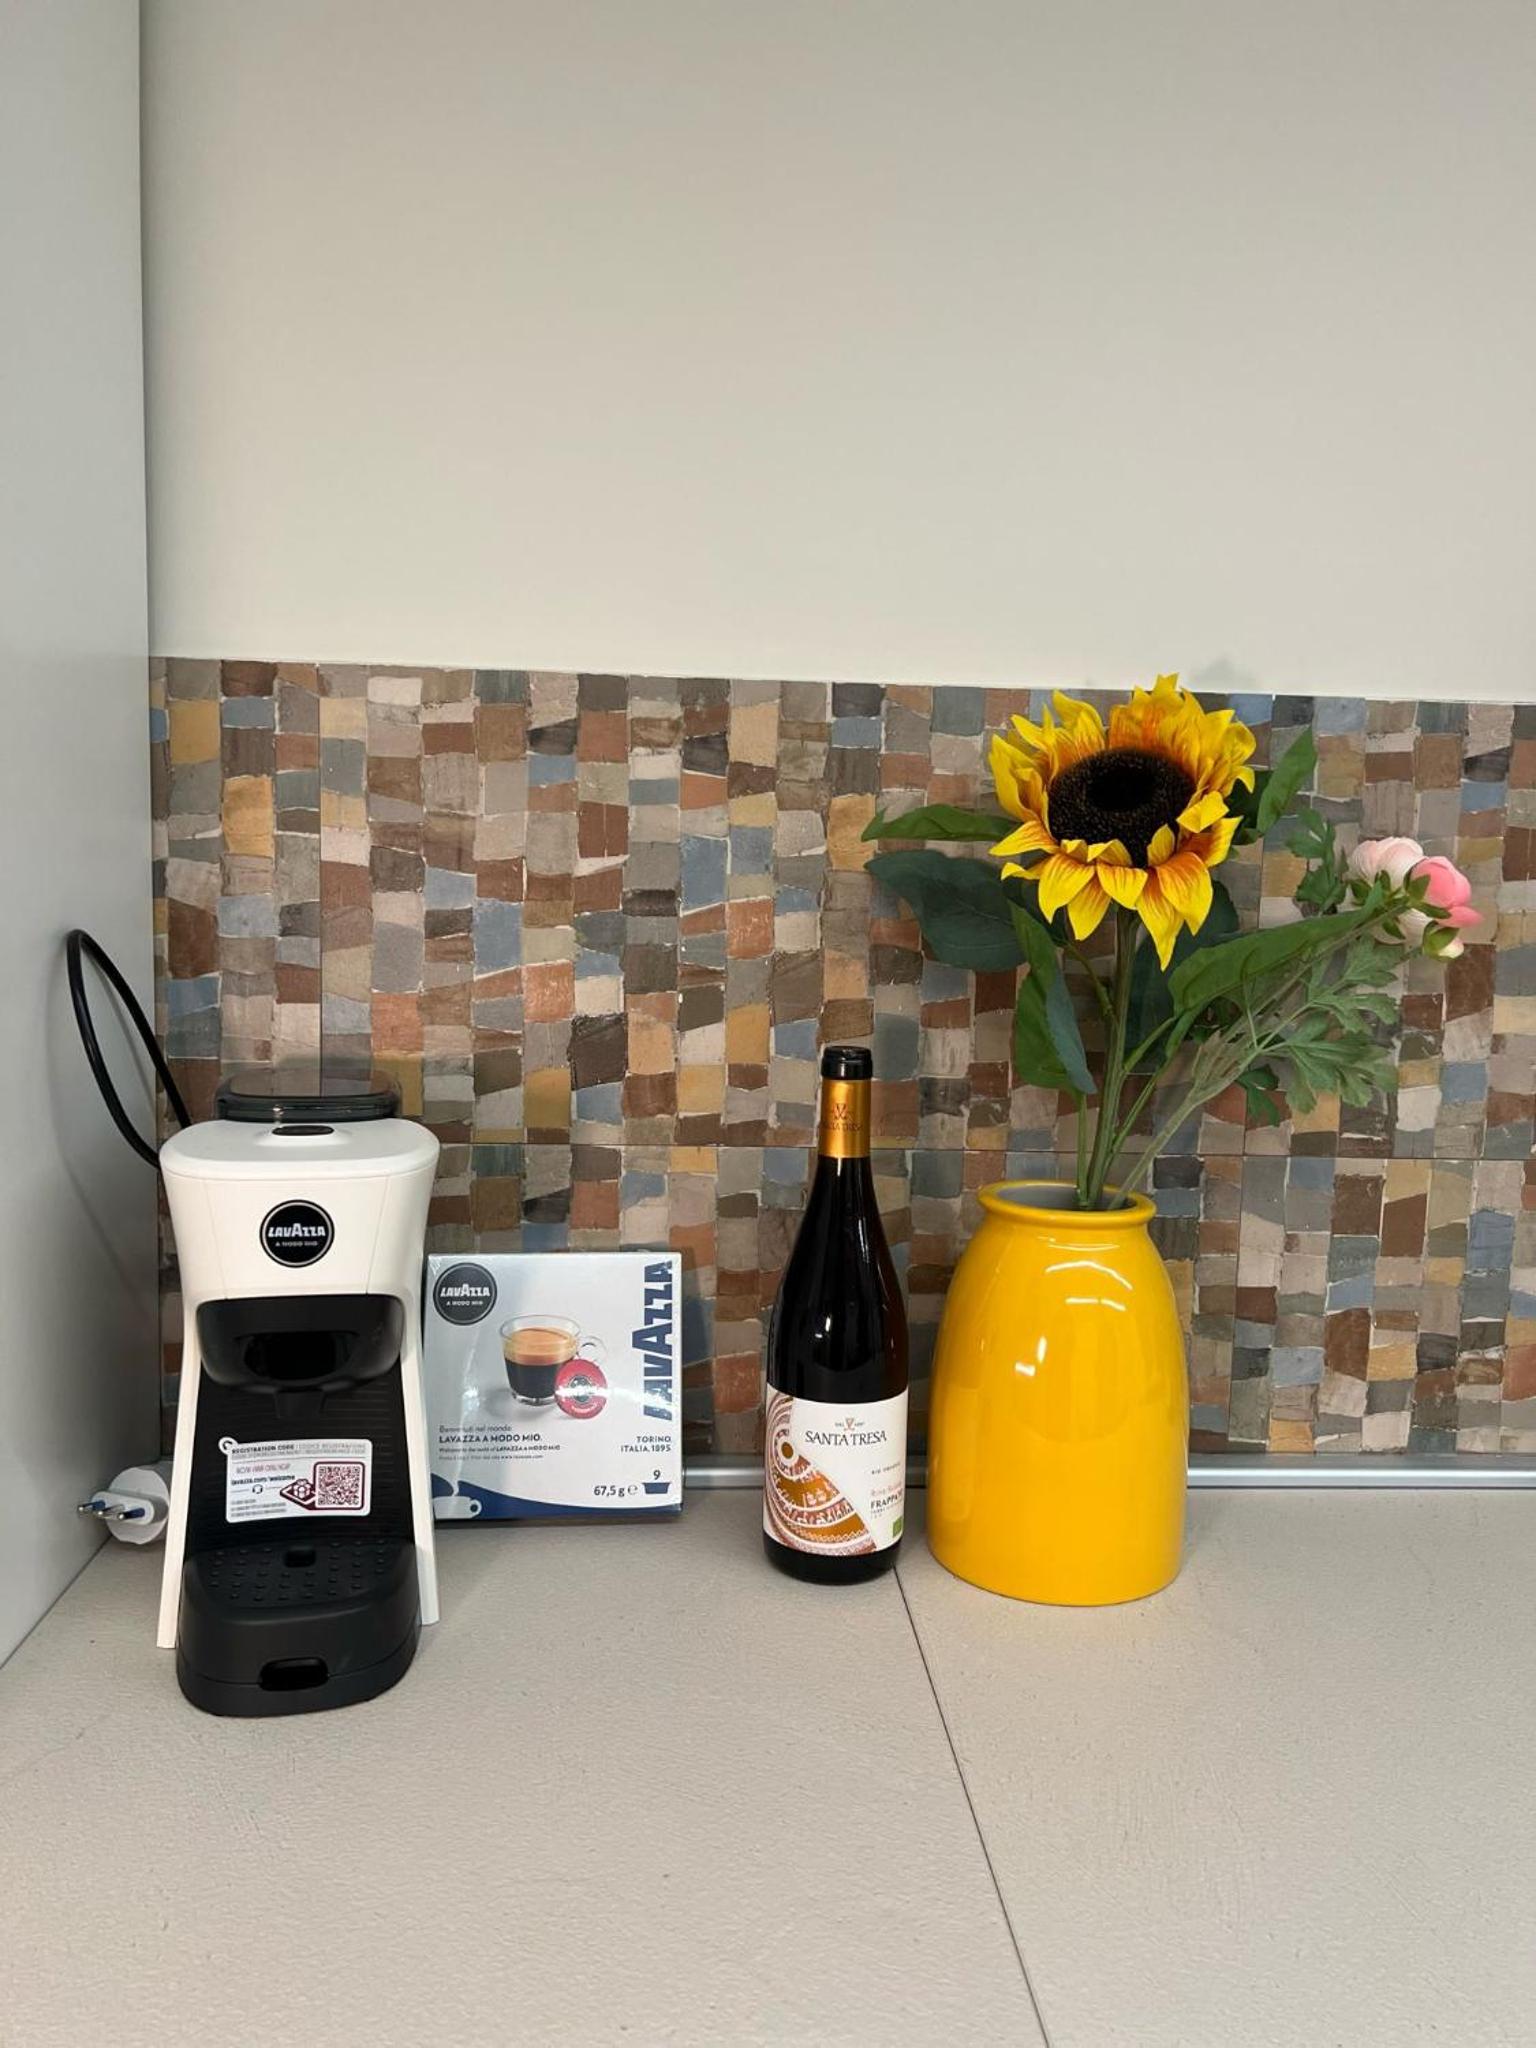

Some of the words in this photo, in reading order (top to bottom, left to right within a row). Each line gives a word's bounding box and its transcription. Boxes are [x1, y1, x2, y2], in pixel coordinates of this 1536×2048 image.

[268, 1223, 326, 1238] LAVAZZA
[440, 1283, 491, 1297] LAVAZZA
[632, 1260, 673, 1421] LAVAZZA
[439, 1435, 481, 1444] LAVAZZA
[482, 1435, 489, 1443] A
[490, 1434, 521, 1443] MODO
[636, 1435, 672, 1443] TORINO
[804, 1430, 849, 1446] SANTA
[850, 1430, 887, 1446] TRESA
[231, 1445, 277, 1454] REGISTRATION
[652, 1444, 672, 1452] 1895
[653, 1469, 661, 1481] 9
[593, 1485, 617, 1497] 67,5
[618, 1487, 626, 1498] g
